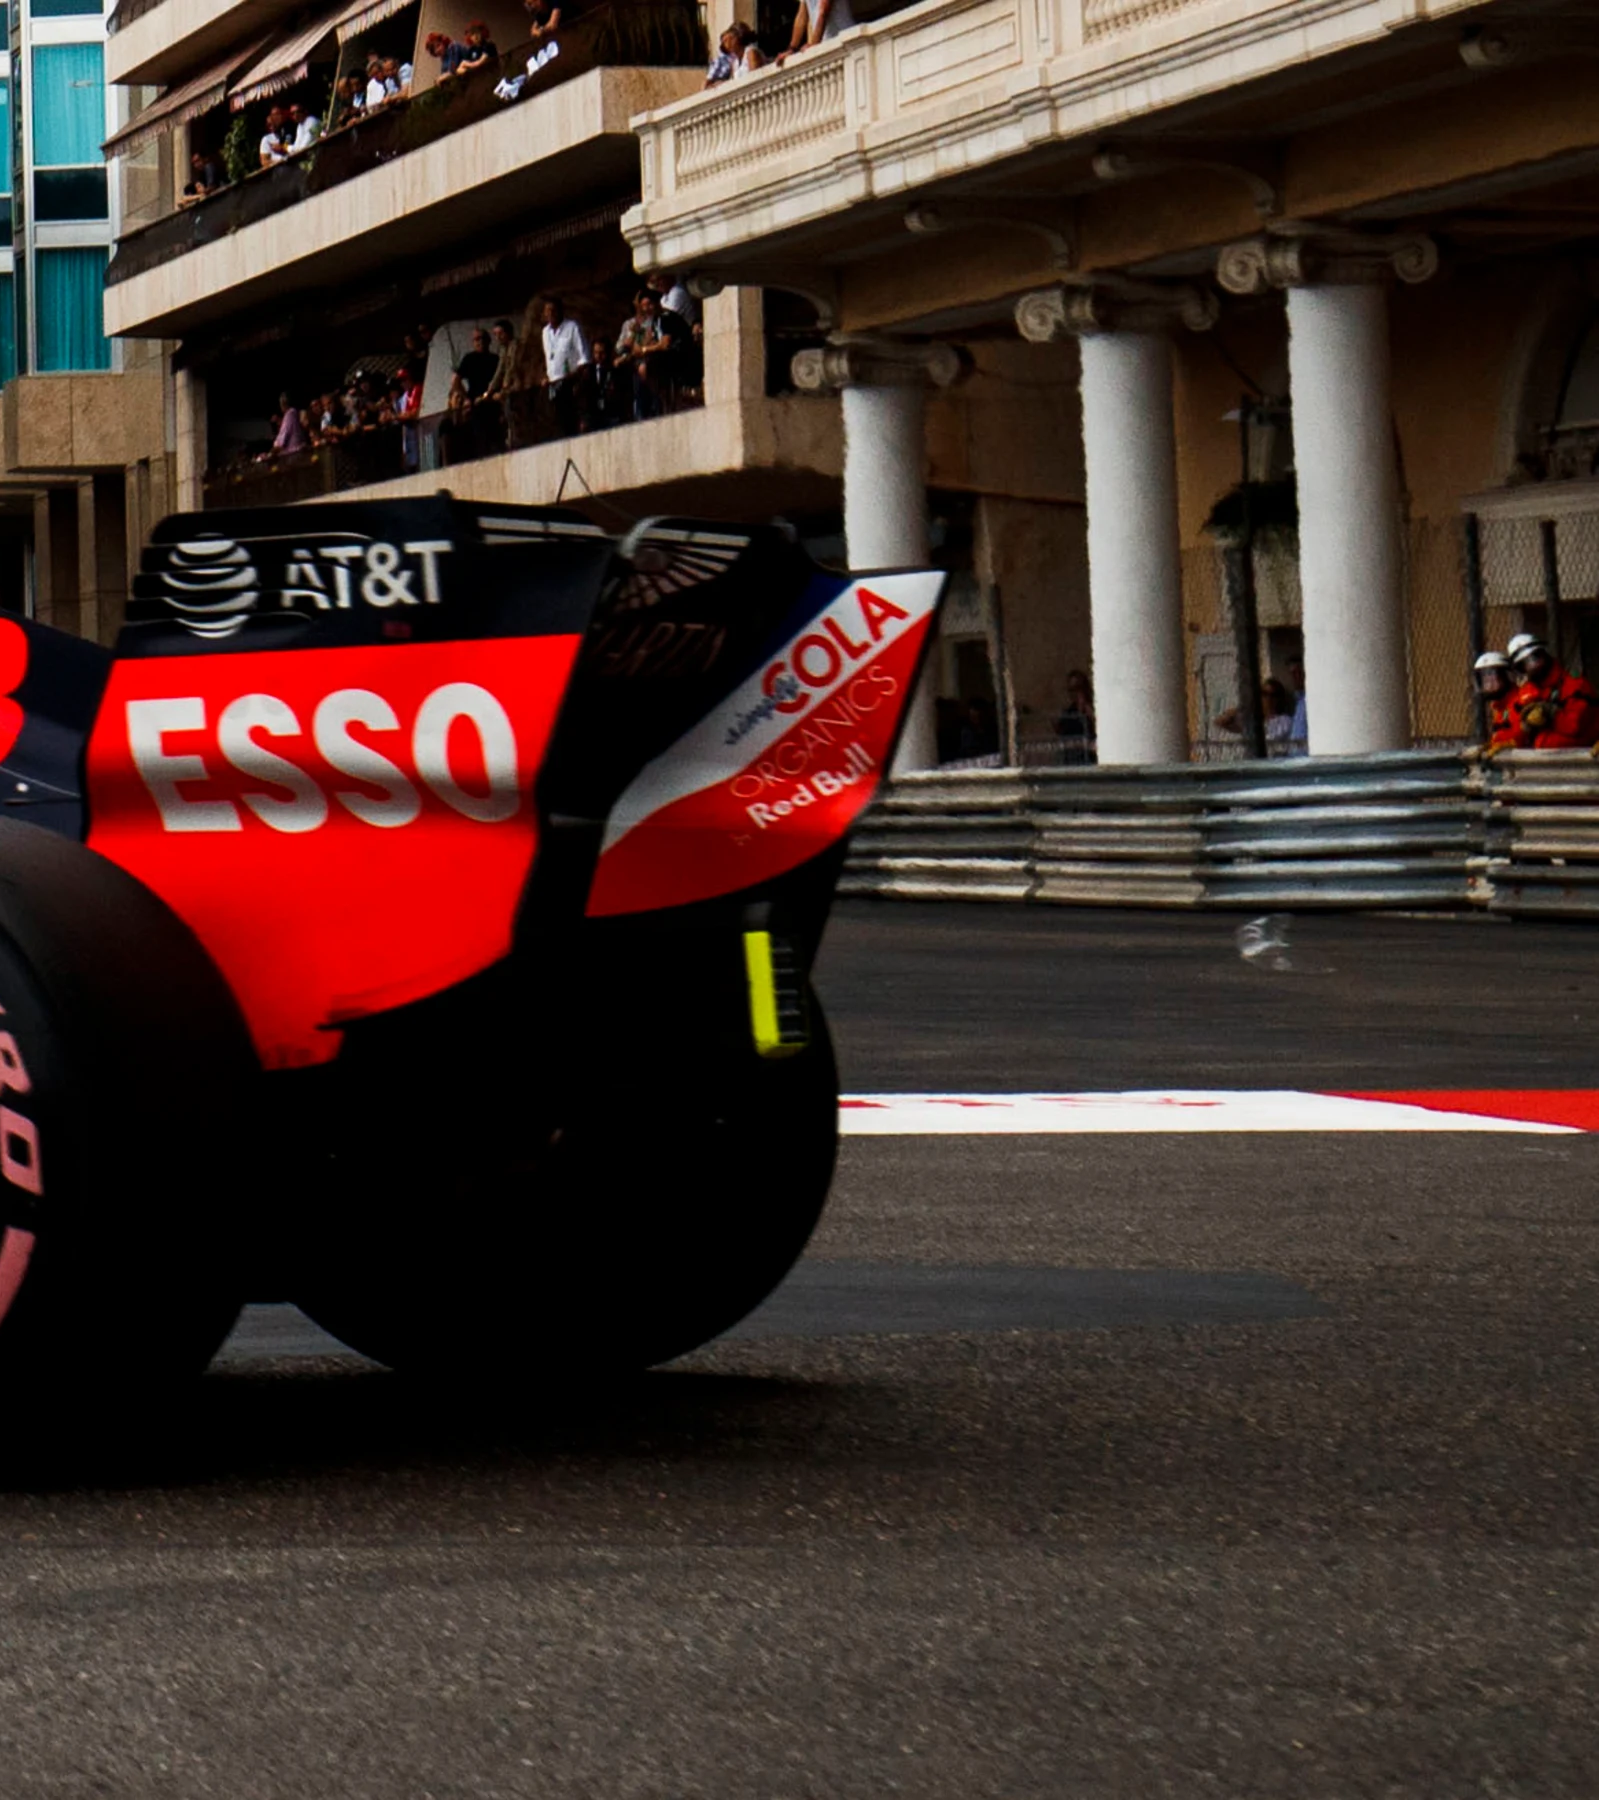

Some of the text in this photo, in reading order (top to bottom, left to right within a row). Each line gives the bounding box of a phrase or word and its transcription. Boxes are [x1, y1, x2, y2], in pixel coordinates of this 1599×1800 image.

[281, 541, 453, 610] AT&T
[761, 586, 910, 715] COLA
[126, 682, 521, 834] ESSO
[729, 665, 899, 799] ORGANICS
[745, 741, 876, 830] Red Bull
